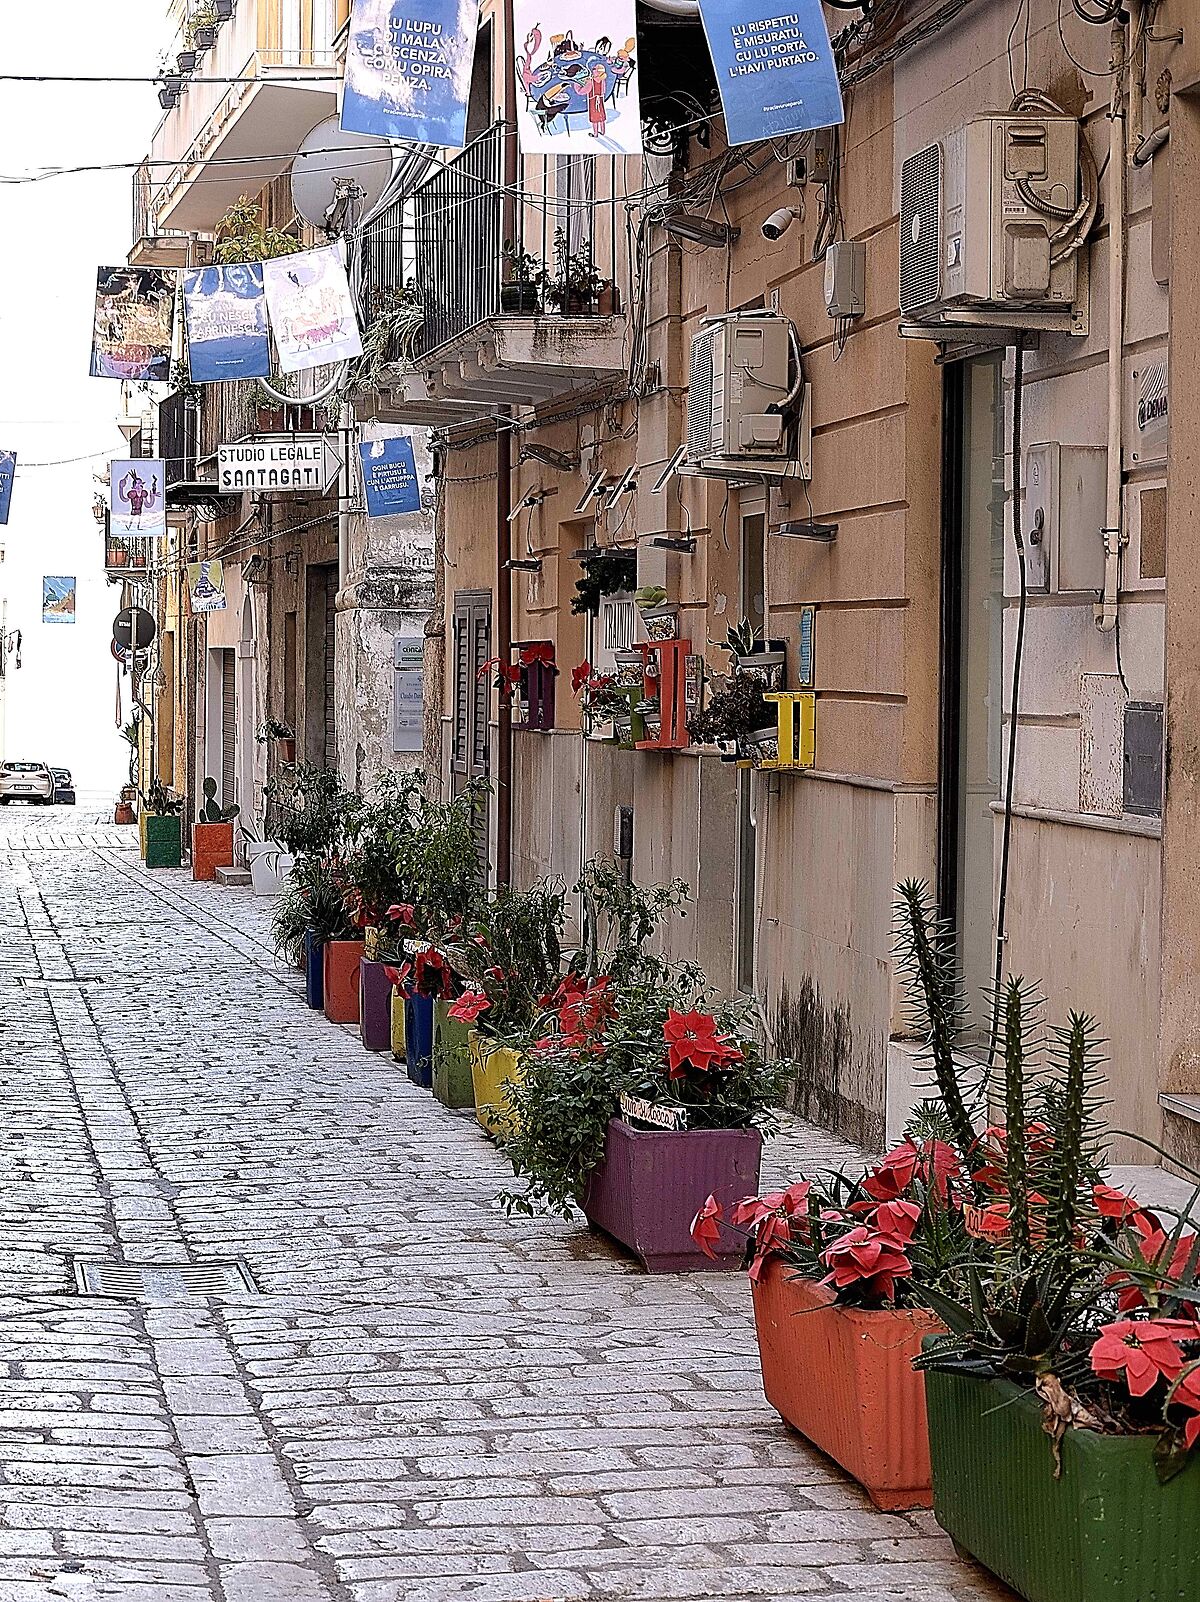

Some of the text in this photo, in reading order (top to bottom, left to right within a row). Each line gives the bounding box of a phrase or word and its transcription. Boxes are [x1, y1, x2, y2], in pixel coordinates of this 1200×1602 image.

[387, 18, 442, 36] LU LUPU
[731, 14, 799, 36] LU RISPETTU
[384, 32, 440, 50] DI MALA
[734, 28, 803, 49] È MISURATU,
[373, 43, 448, 65] CUSCENZA
[736, 40, 807, 62] CU LU PORTA
[364, 57, 453, 80] COMU OPIRA
[729, 52, 820, 78] L'HAVI PURTATO.
[382, 72, 432, 91] PENZA.
[220, 446, 321, 462] STUDIO LEGALE
[389, 461, 406, 470] BUCU
[222, 467, 319, 487] SANTAGATI
